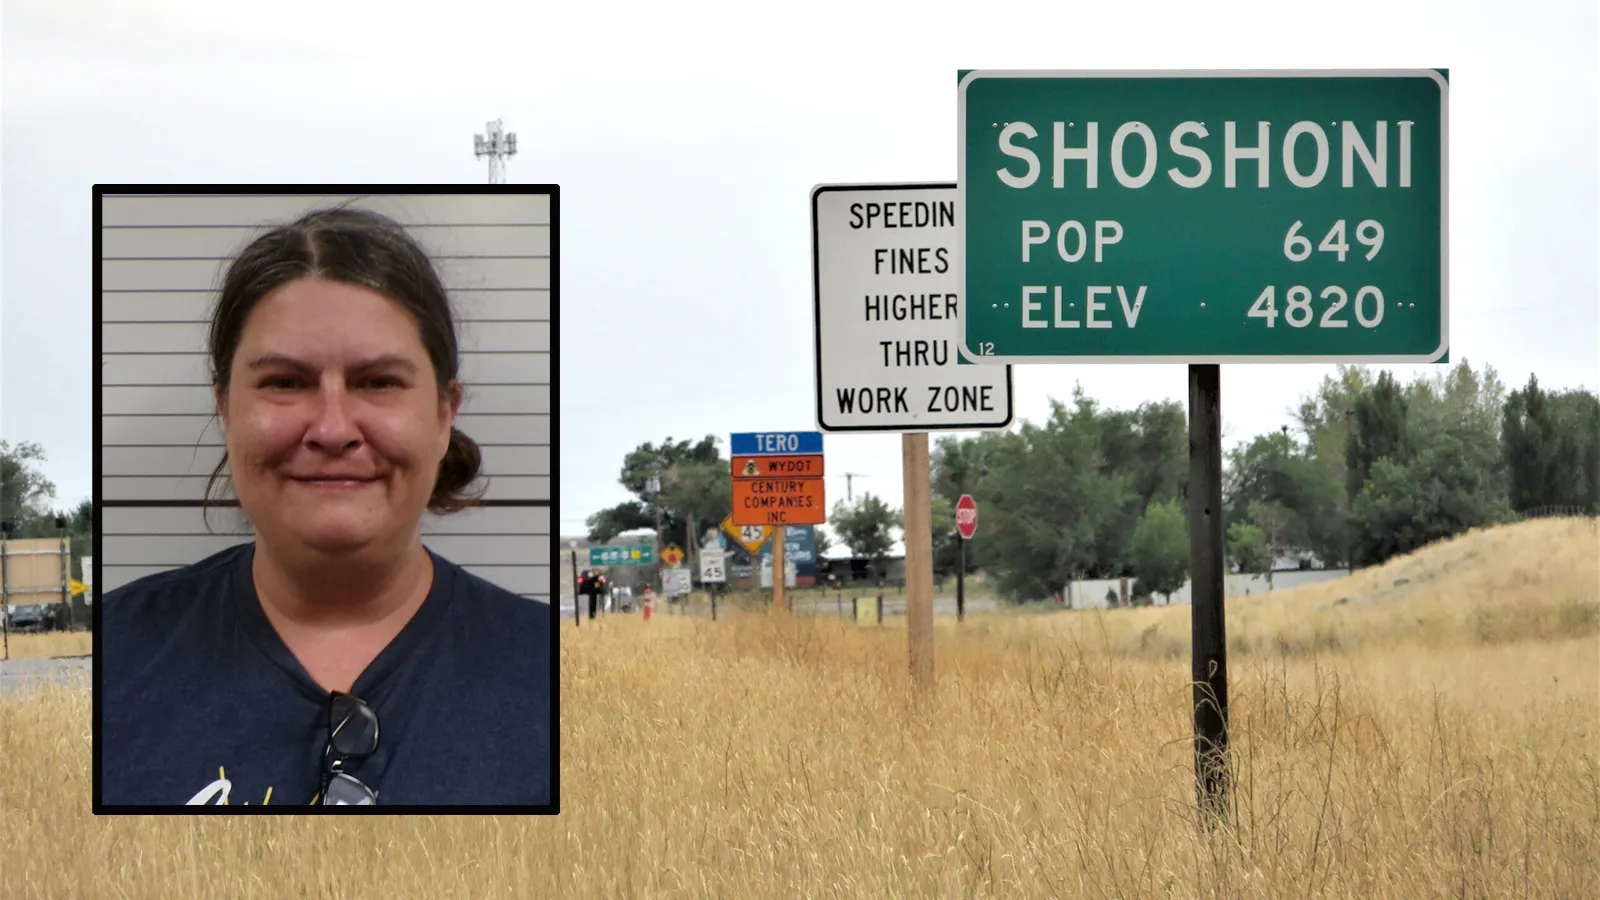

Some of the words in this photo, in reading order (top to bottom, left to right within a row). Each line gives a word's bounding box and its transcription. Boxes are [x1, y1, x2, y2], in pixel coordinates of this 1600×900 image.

[996, 120, 1412, 189] SHOSHONI
[849, 201, 956, 230] SPEEDIN
[1022, 220, 1124, 263] POP
[1283, 219, 1385, 262] 649
[875, 247, 949, 275] FINES
[865, 294, 958, 321] HIGHER
[1022, 285, 1148, 329] ELEV
[1247, 285, 1385, 328] 4820
[880, 340, 948, 367] THRU
[979, 341, 995, 356] 12
[837, 387, 909, 414] WORK
[927, 386, 994, 413] ZONE
[755, 433, 799, 452] TERO
[768, 460, 812, 472] WYDOT
[751, 481, 805, 494] CENTURY
[744, 495, 813, 509] COMPANIES
[767, 511, 787, 522] INC
[957, 508, 977, 525] STOP
[743, 525, 762, 540] 45
[704, 567, 723, 578] 45
